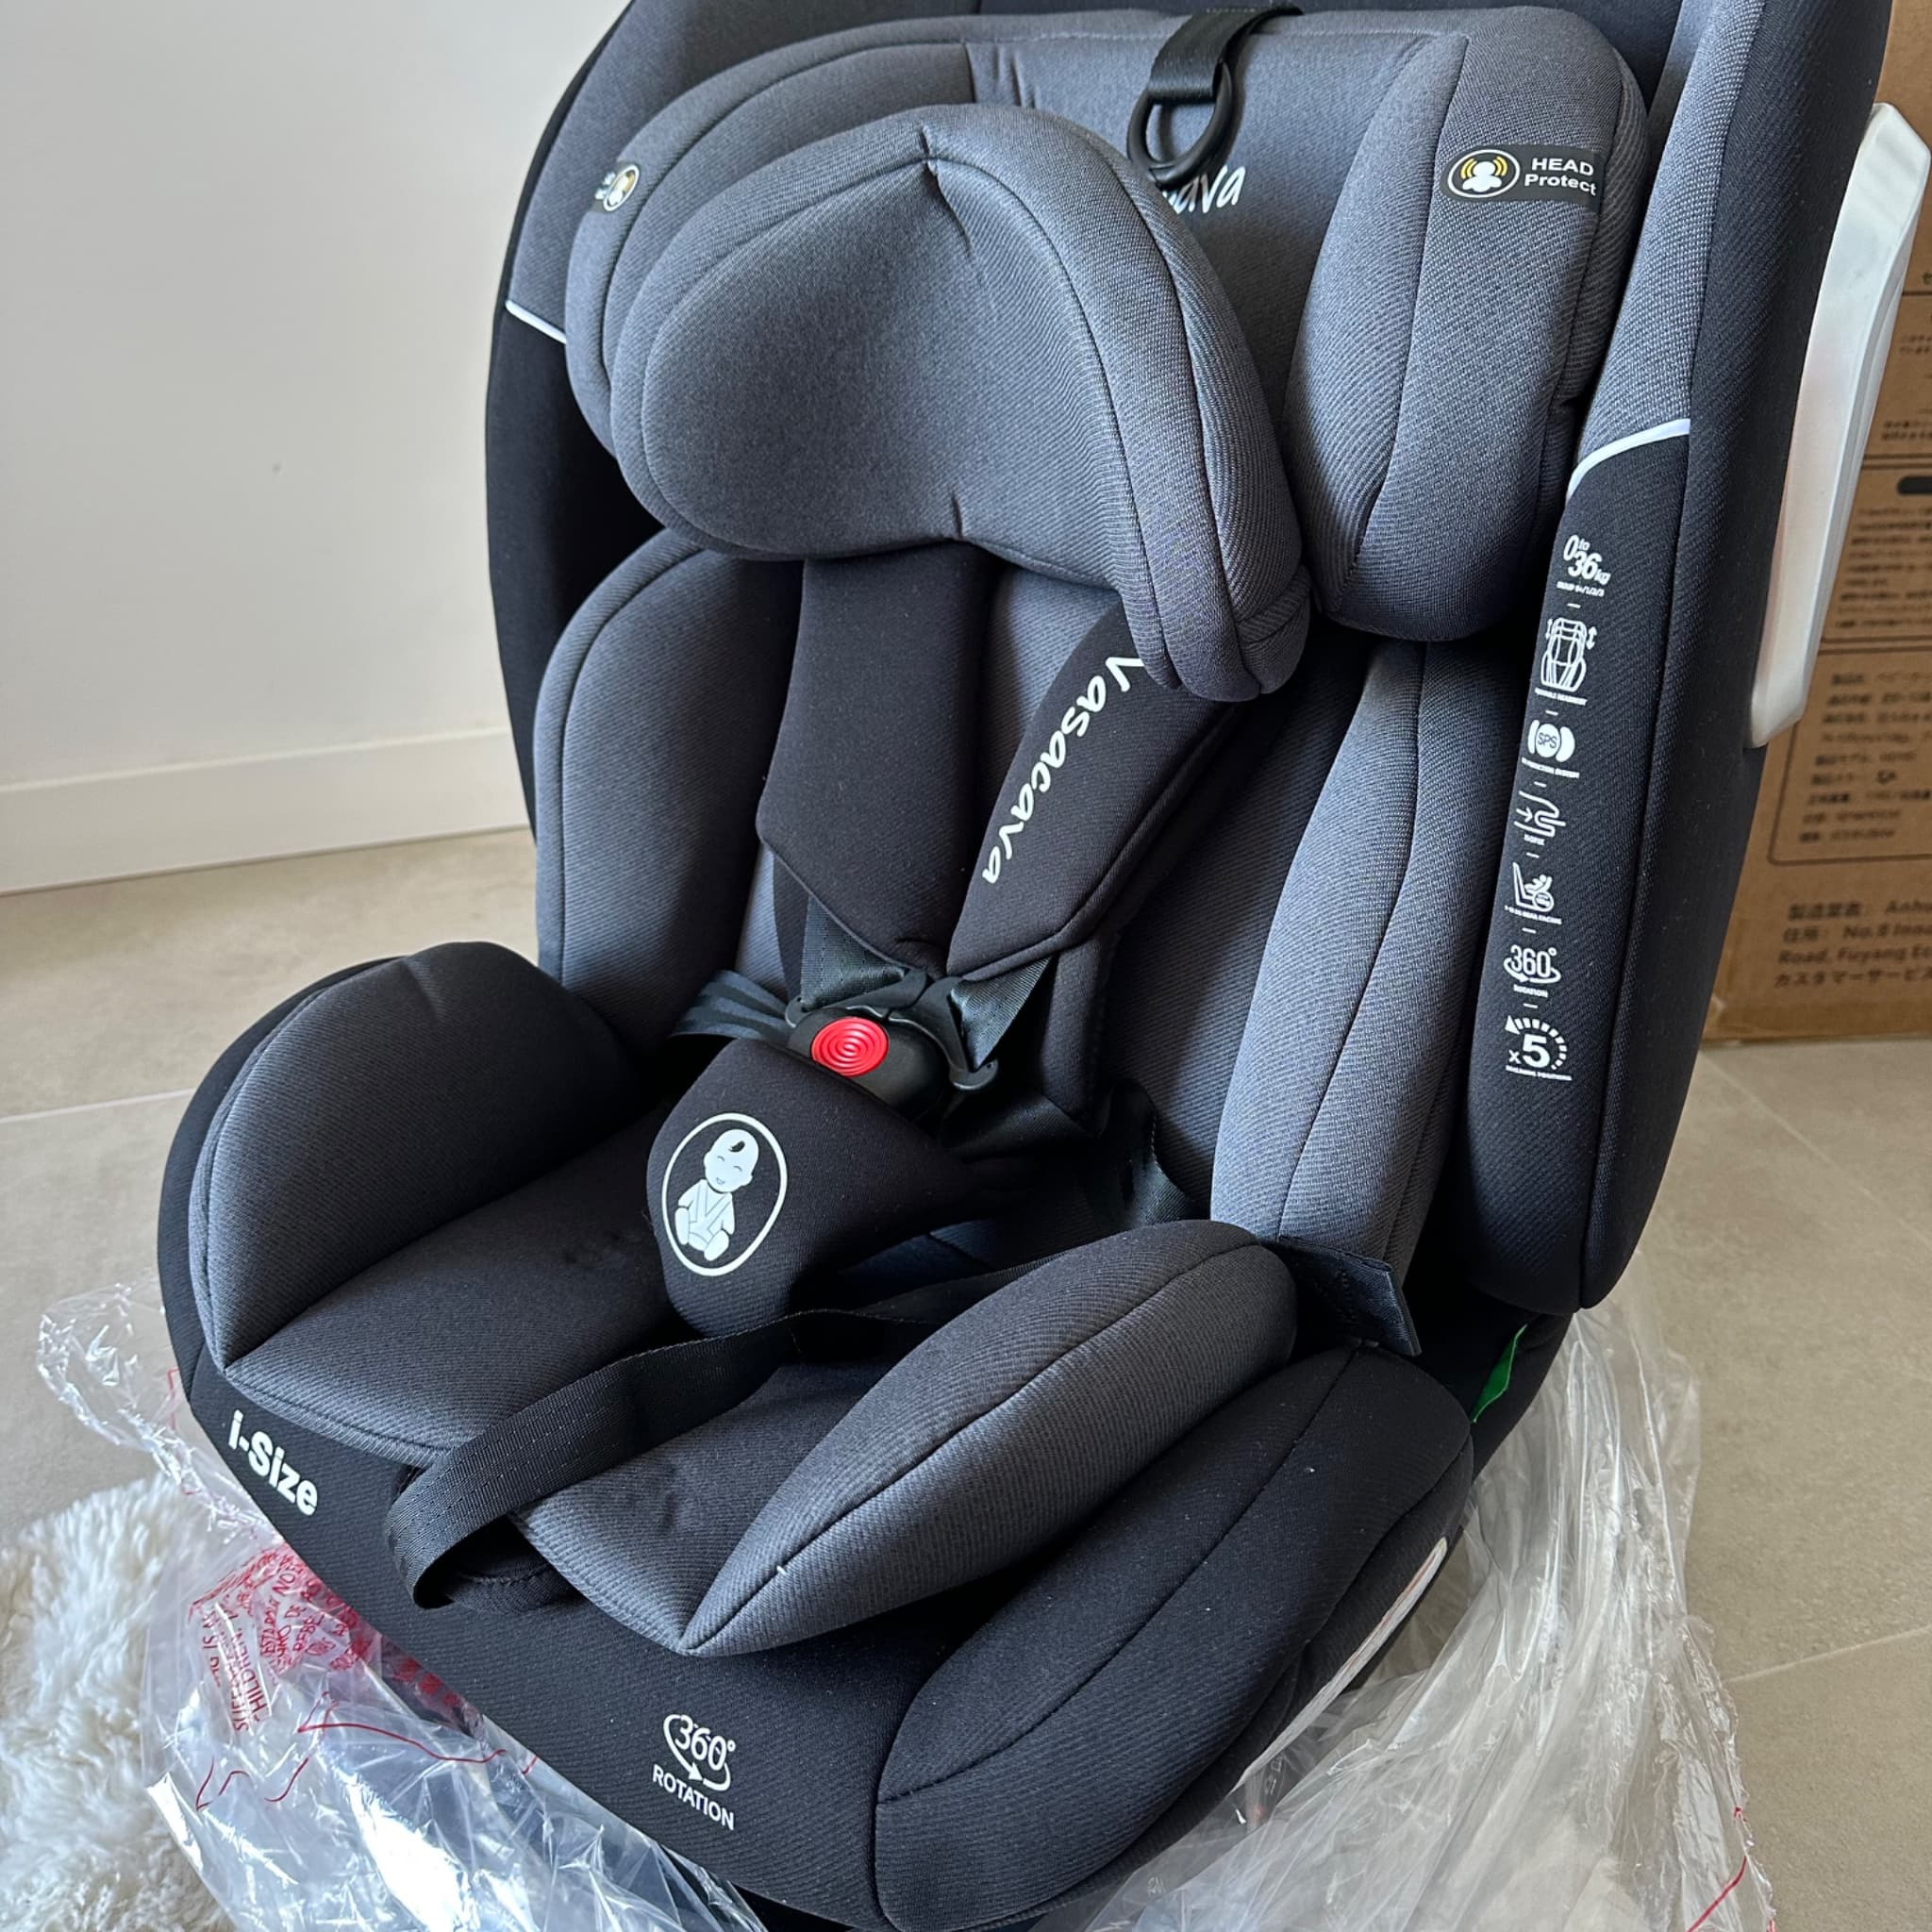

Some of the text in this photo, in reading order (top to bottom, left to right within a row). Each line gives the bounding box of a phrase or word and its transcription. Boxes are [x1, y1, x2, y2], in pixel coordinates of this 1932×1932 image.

[1524, 174, 1596, 196] Protect
[1531, 158, 1594, 176] HEAD
[1538, 732, 1557, 748] SPS
[982, 657, 1144, 884] Vasacava
[228, 1409, 318, 1516] i-Size
[652, 1763, 735, 1831] ROTATION
